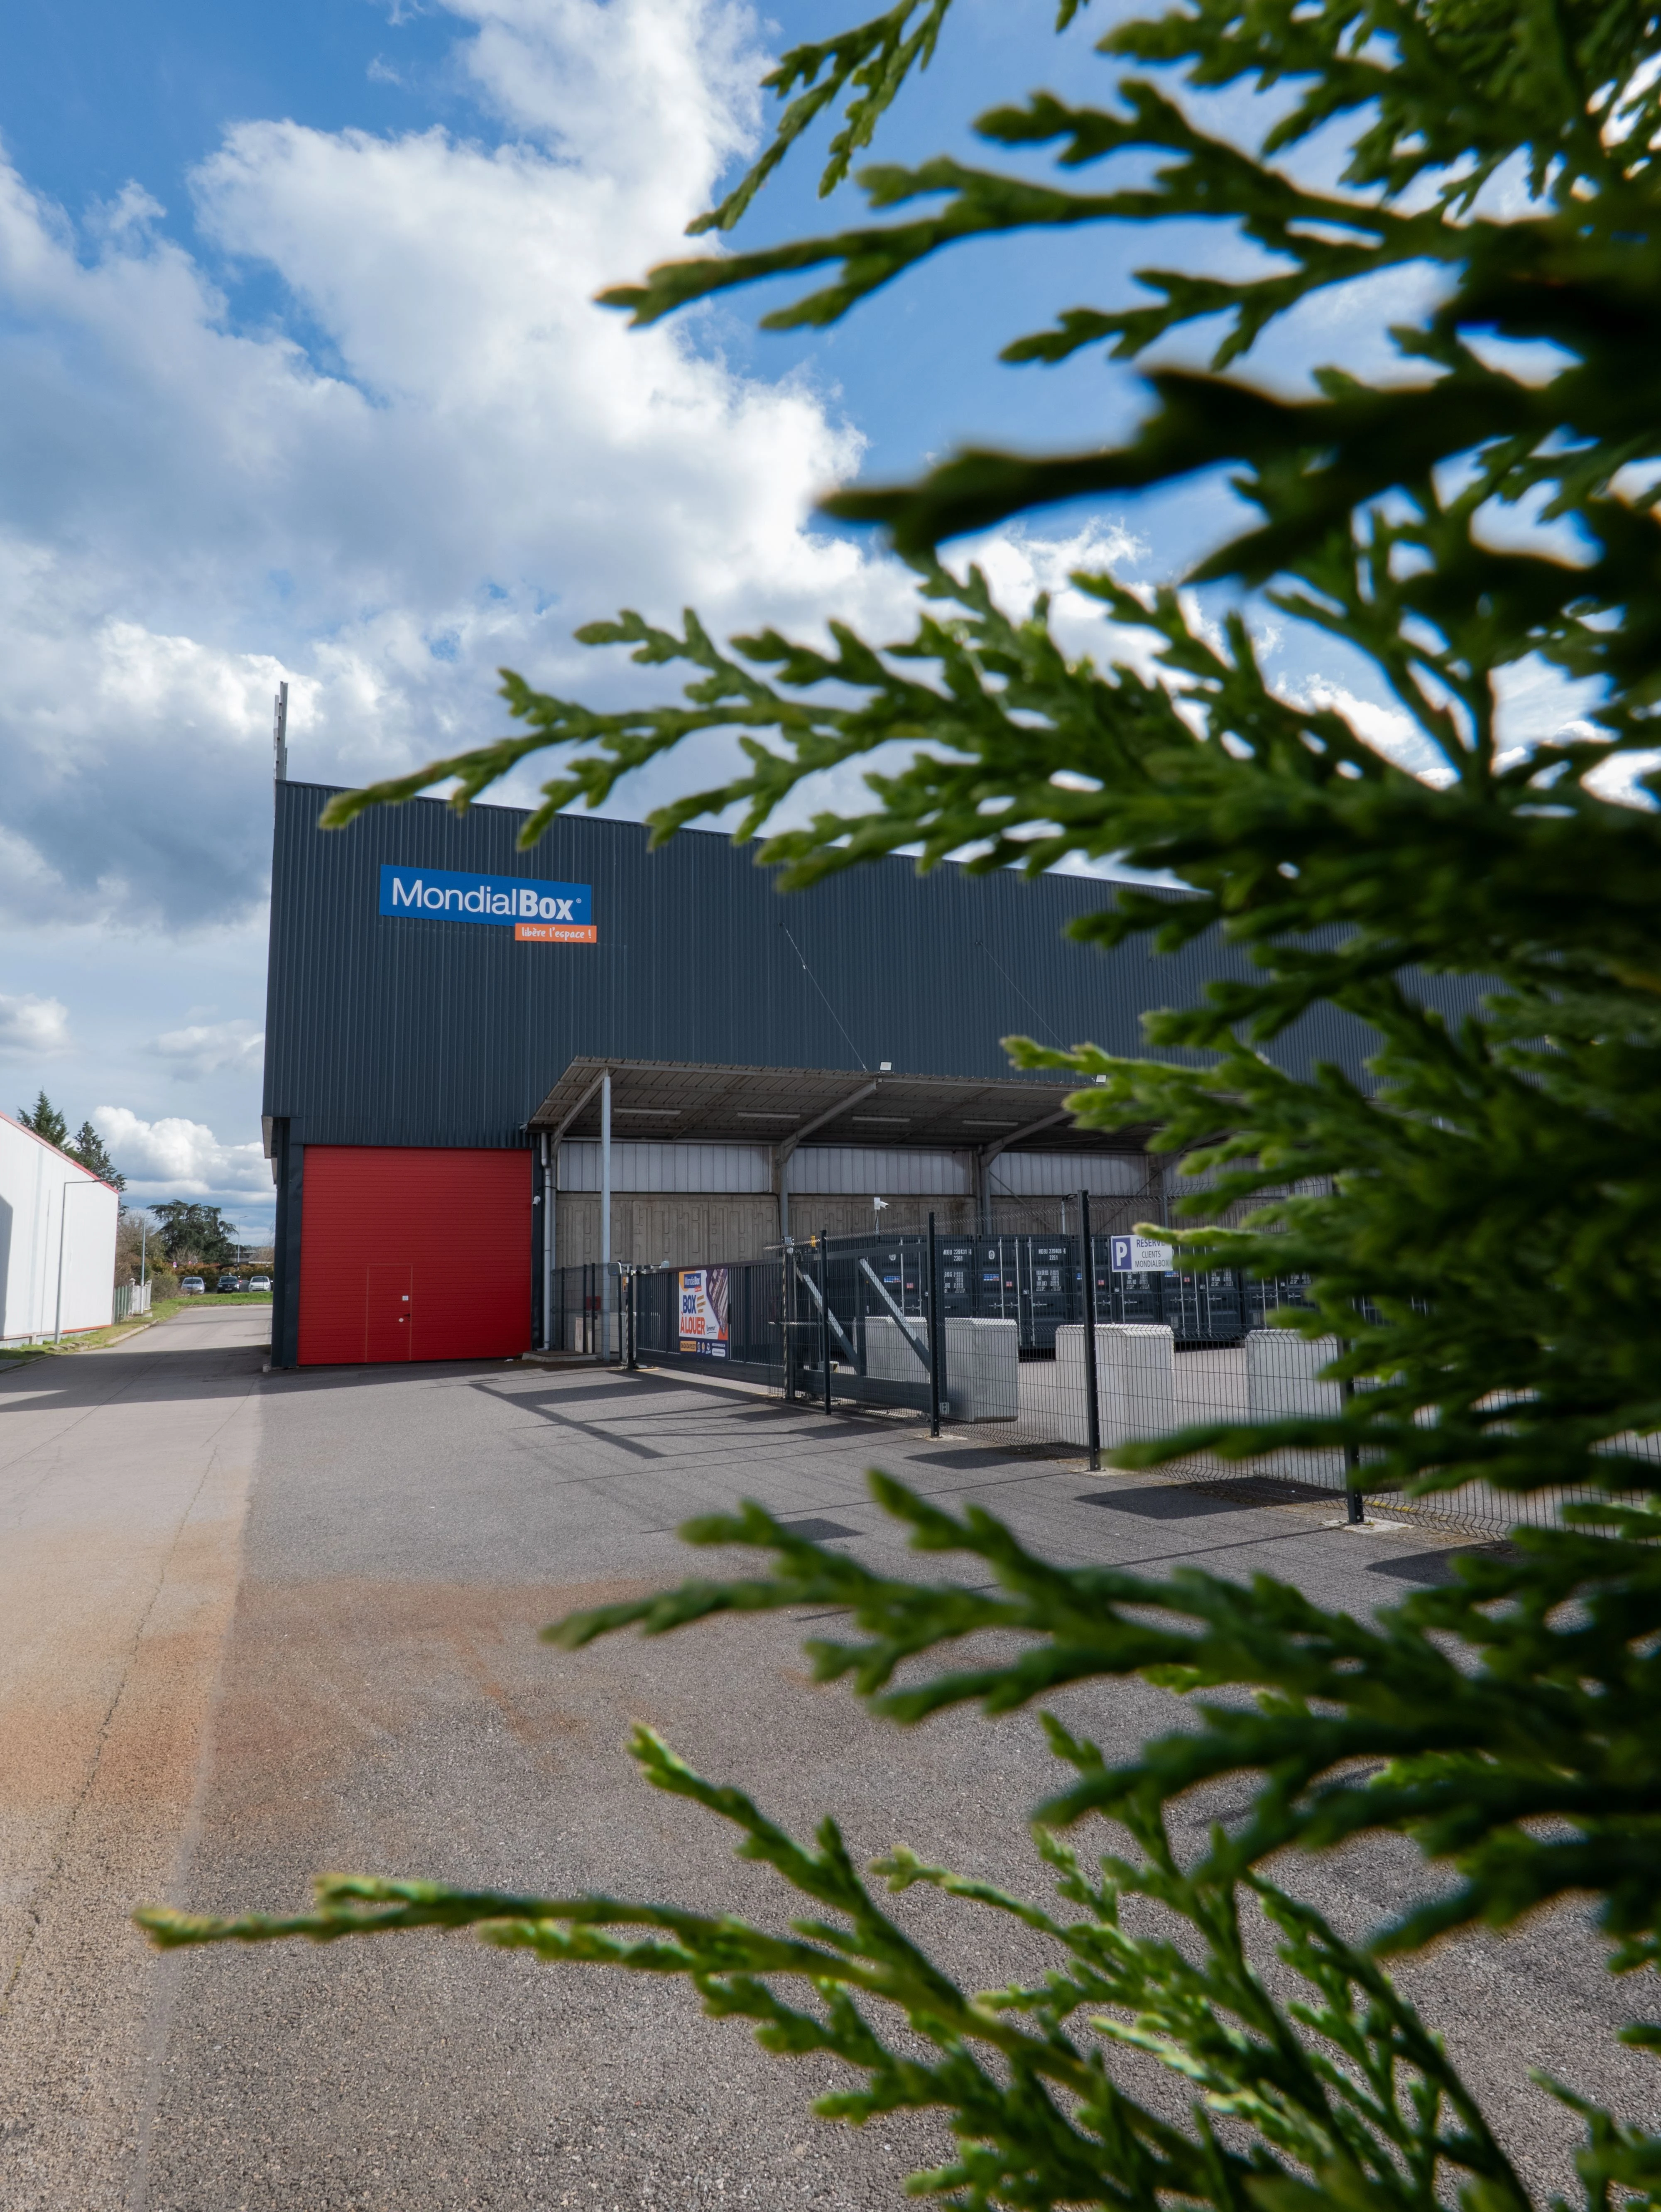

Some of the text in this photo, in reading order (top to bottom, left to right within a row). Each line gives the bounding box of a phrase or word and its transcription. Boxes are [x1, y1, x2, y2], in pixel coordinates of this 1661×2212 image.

[522, 927, 546, 937] libère
[1116, 1241, 1127, 1266] P
[1135, 1260, 1169, 1268] MONDIALBOX
[683, 1295, 696, 1314] BOX
[680, 1311, 705, 1335] À LOUER
